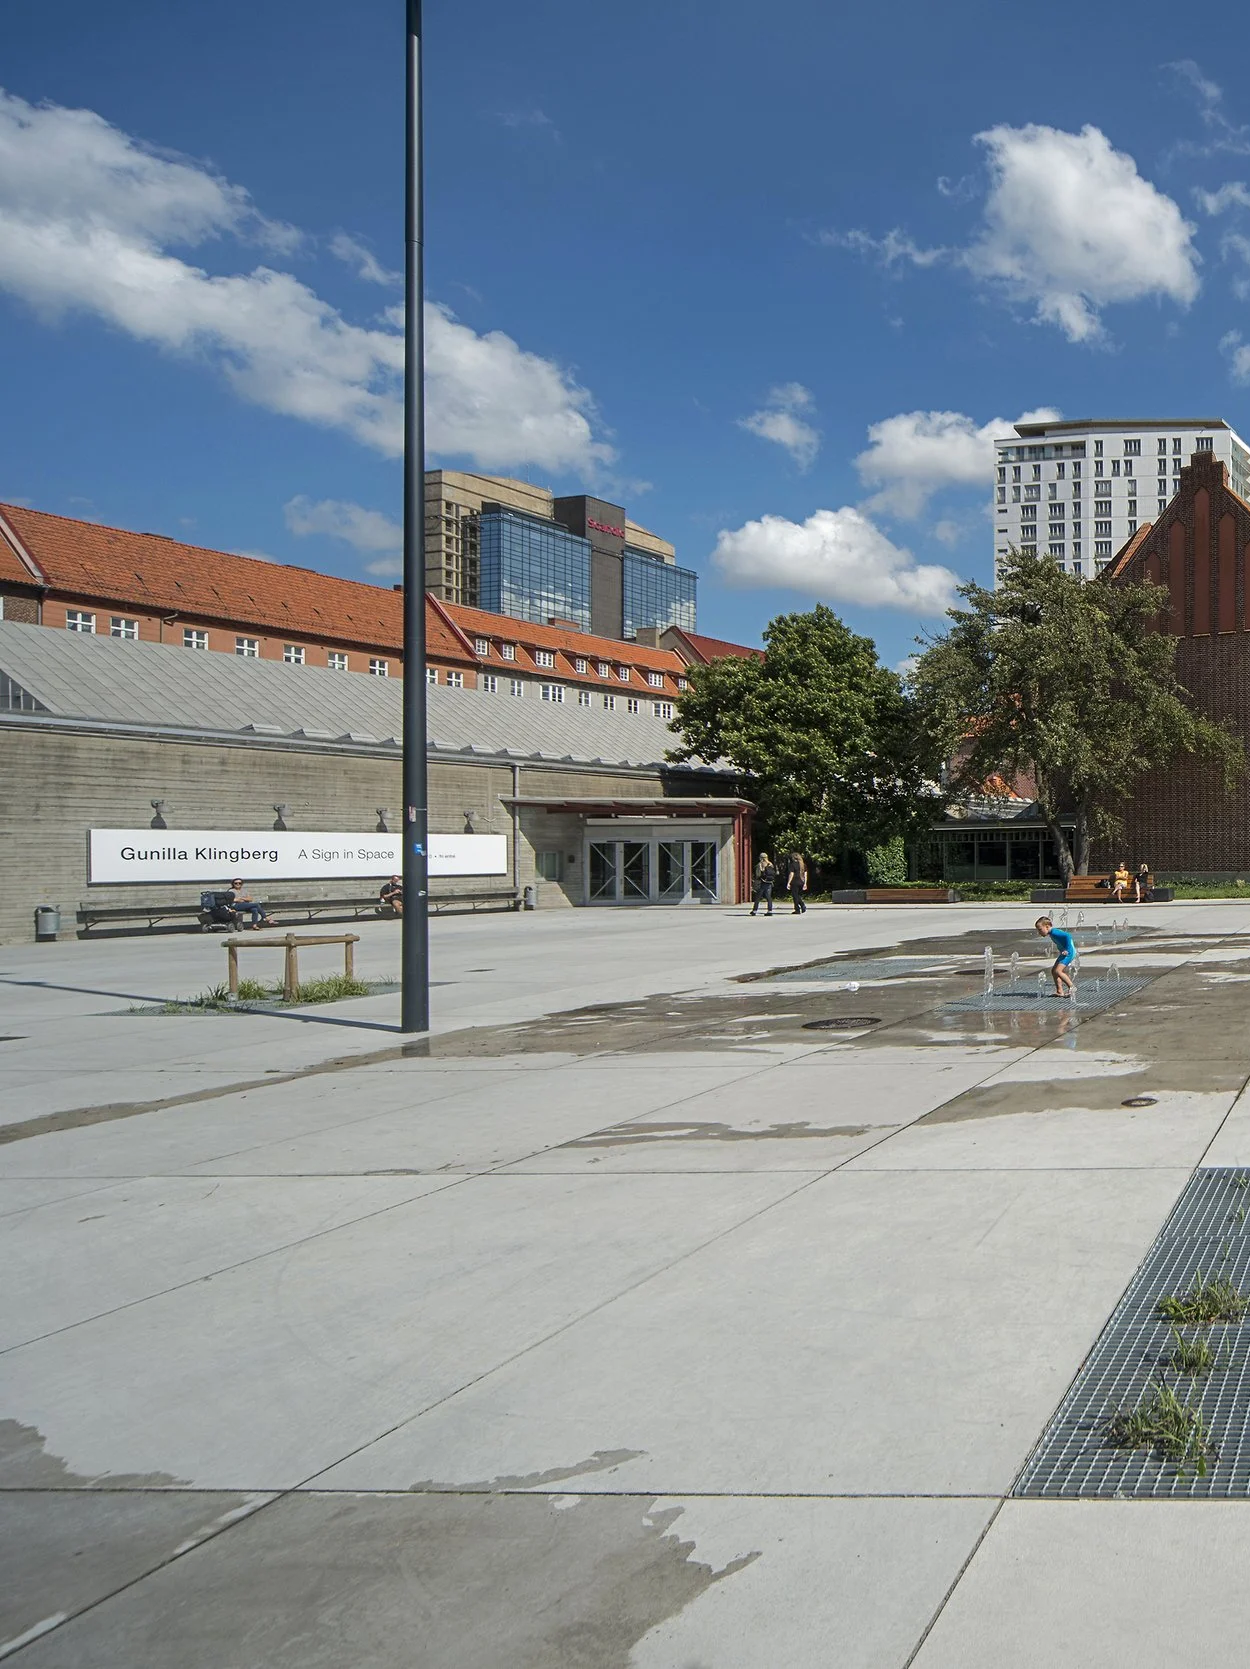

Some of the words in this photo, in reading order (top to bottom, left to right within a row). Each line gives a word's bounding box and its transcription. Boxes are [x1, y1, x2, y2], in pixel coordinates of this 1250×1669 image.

[120, 846, 189, 861] Gunilla
[195, 846, 279, 863] Klingberg
[298, 848, 308, 860] A
[311, 848, 340, 862] Sign
[343, 848, 354, 859] in
[357, 848, 395, 862] Space
